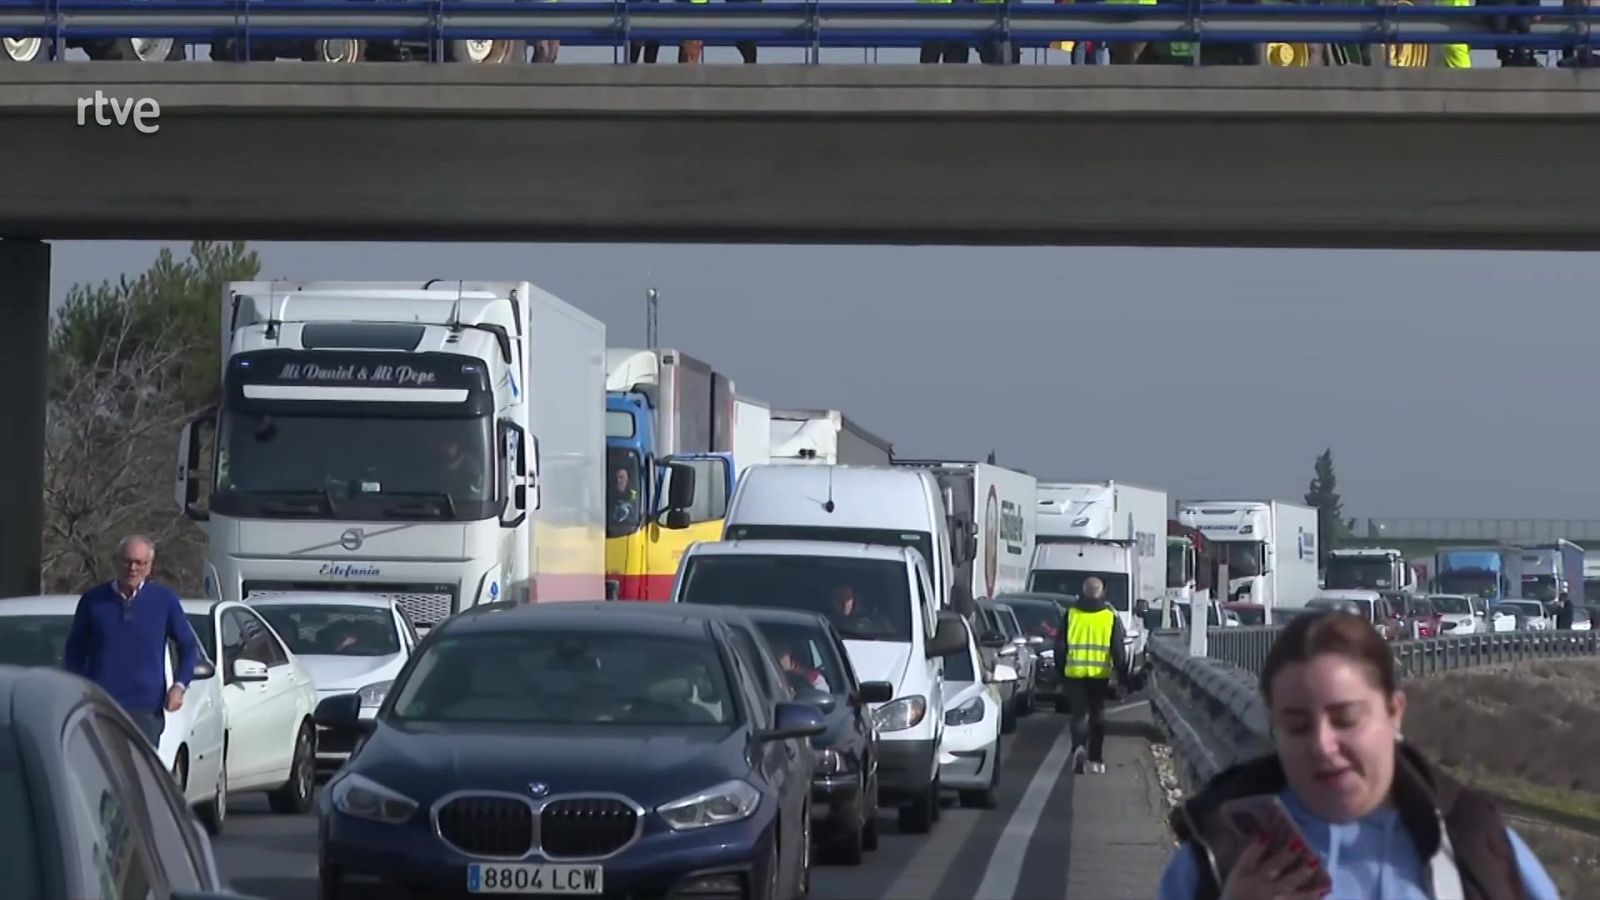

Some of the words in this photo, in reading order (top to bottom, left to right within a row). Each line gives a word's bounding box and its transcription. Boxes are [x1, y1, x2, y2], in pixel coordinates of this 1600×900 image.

[302, 363, 356, 380] Daniel
[356, 366, 368, 381] &
[395, 365, 437, 385] Pepe
[485, 867, 543, 889] 8804
[552, 869, 597, 890] LCW
